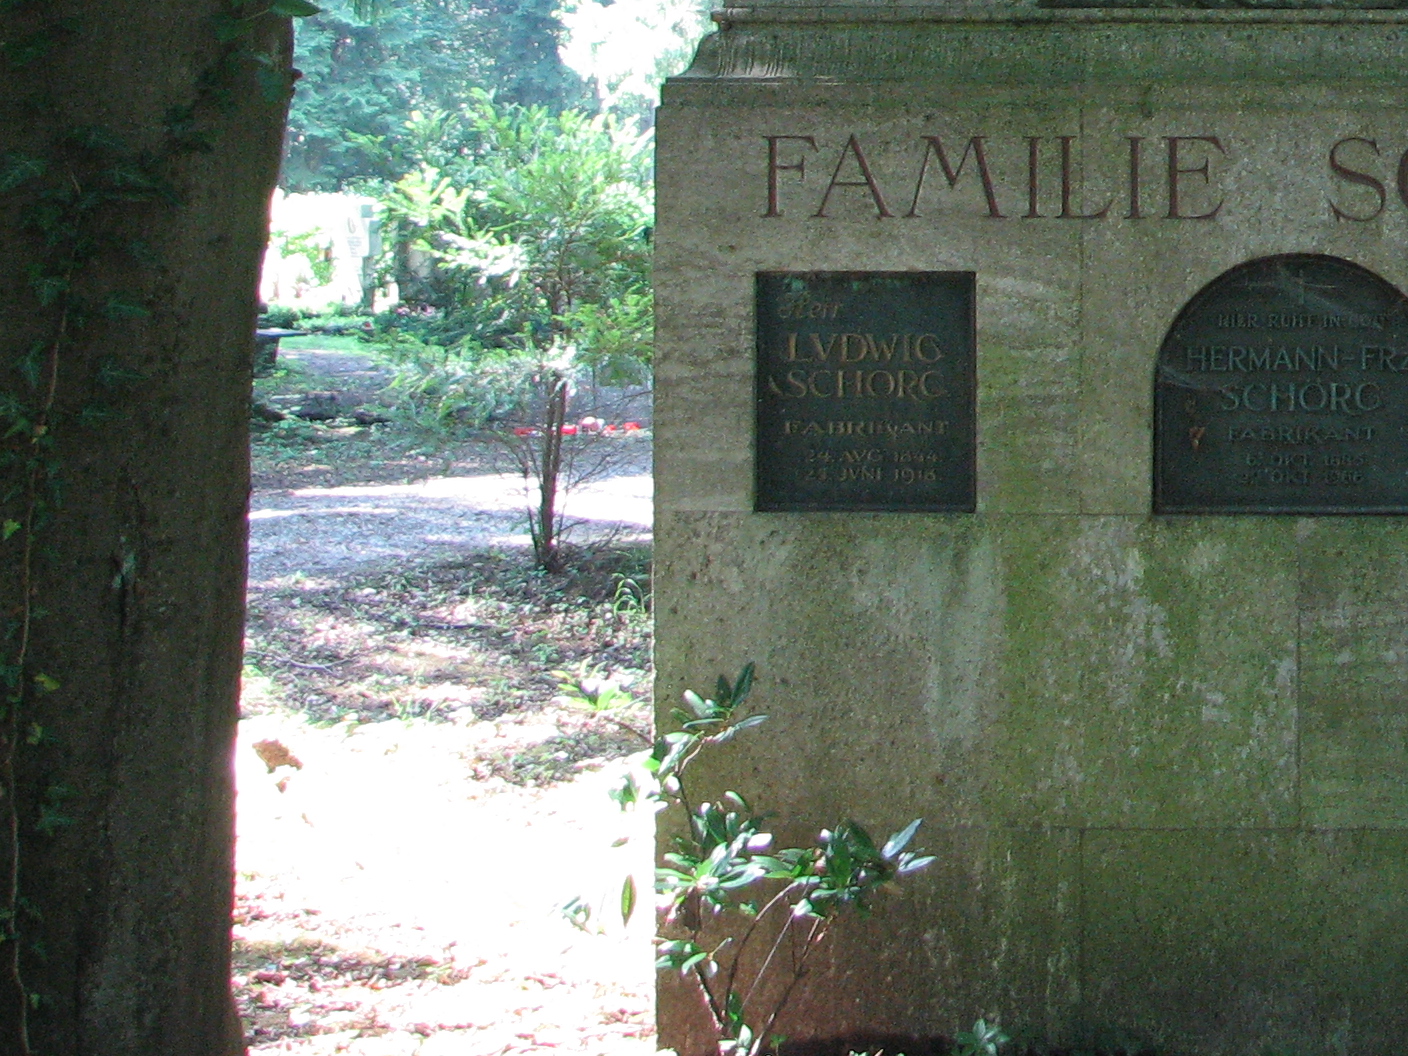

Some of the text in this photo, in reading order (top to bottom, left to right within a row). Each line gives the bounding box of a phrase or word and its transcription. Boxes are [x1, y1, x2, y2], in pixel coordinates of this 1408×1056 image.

[760, 132, 1231, 221] FAMILIE
[1220, 377, 1383, 415] SCHÖRG
[1228, 425, 1375, 442] FABRIKANT
